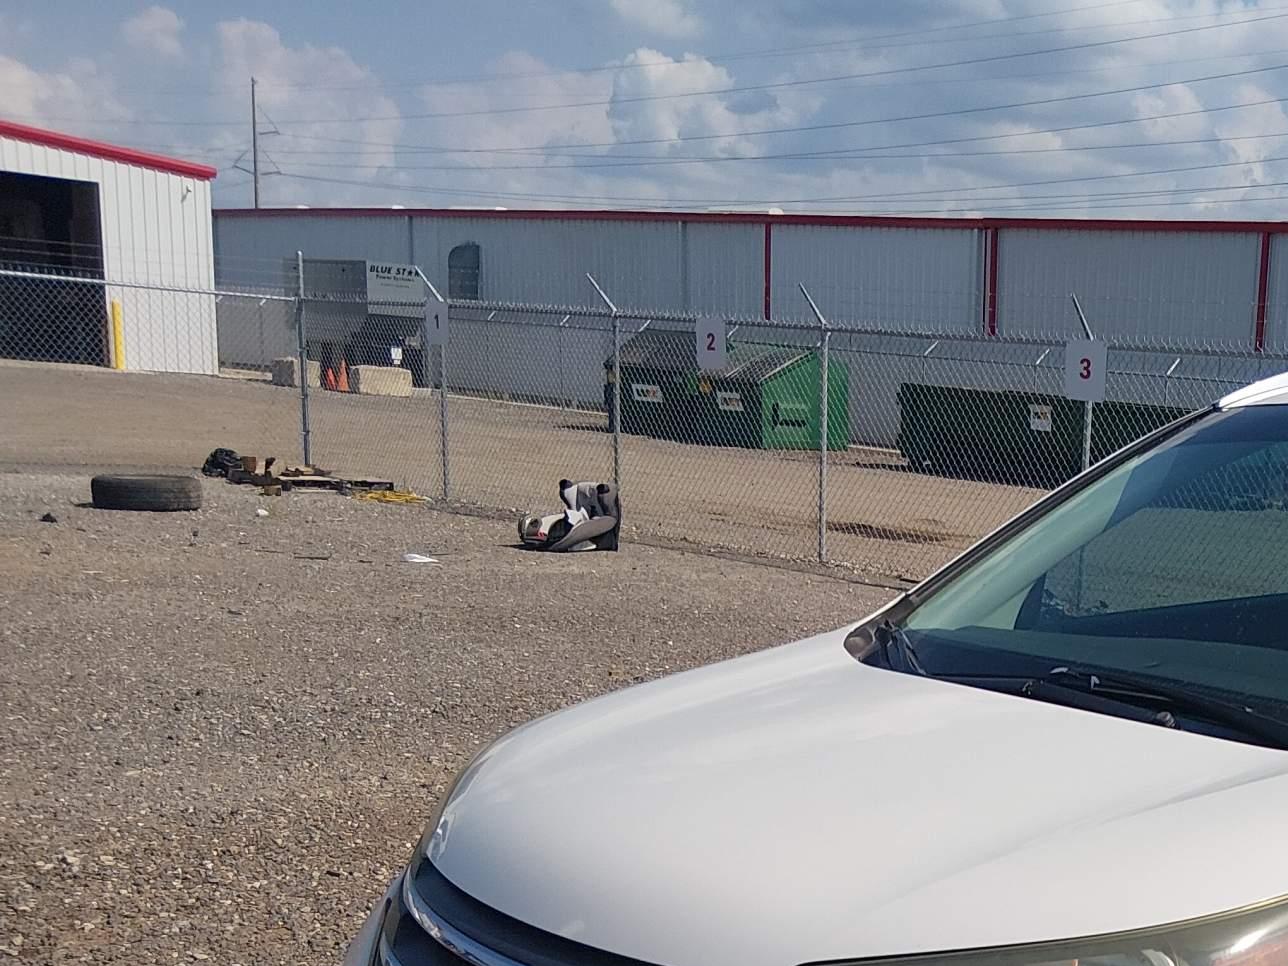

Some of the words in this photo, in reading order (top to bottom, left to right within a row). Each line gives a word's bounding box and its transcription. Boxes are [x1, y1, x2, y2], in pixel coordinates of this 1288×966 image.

[369, 265, 393, 275] BLUE
[434, 314, 439, 329] 1
[706, 333, 715, 351] 2
[1080, 358, 1091, 379] 3
